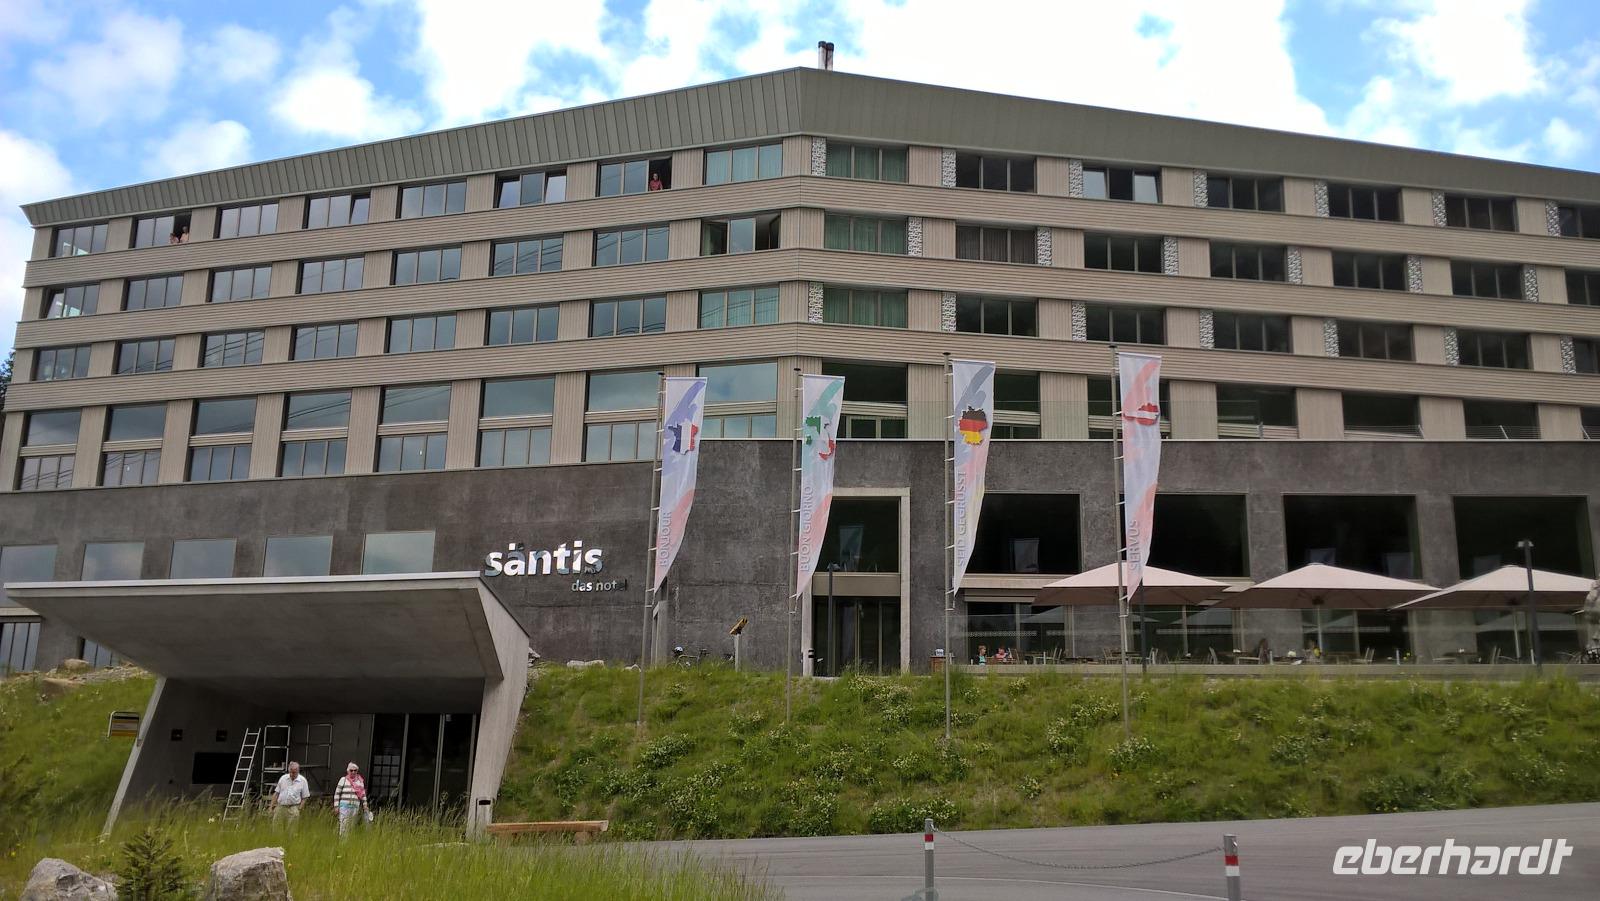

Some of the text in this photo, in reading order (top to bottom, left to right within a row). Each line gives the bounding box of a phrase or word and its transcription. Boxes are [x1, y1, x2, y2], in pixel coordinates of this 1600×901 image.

[659, 511, 672, 567] BONJOUR
[799, 486, 814, 571] BUON GIORNO
[1128, 519, 1141, 571] SERVUS
[484, 540, 604, 577] säntis
[571, 579, 593, 592] das
